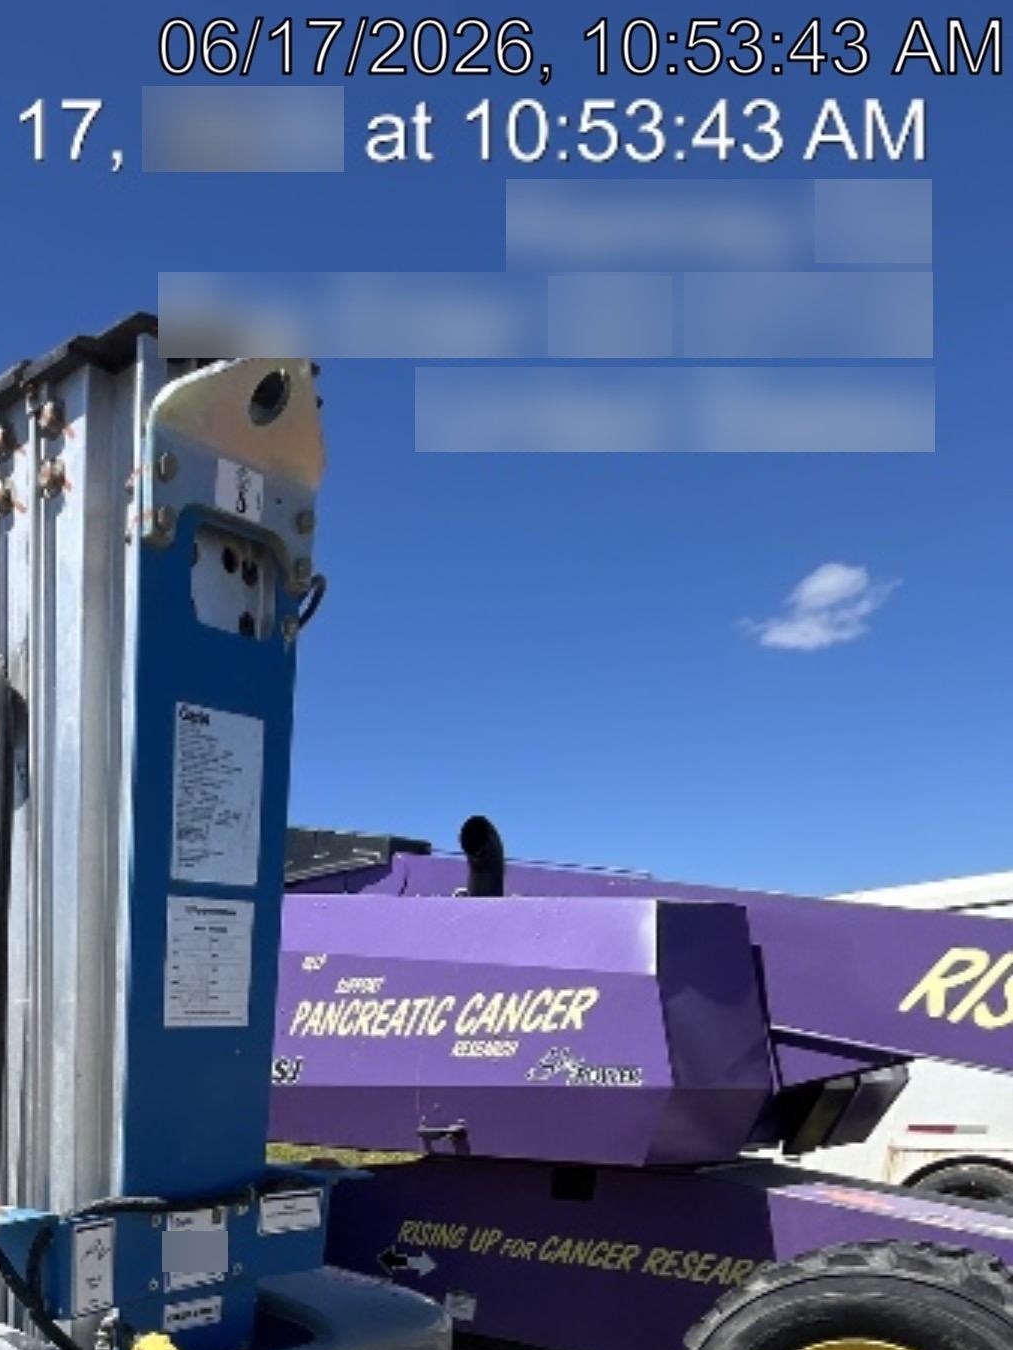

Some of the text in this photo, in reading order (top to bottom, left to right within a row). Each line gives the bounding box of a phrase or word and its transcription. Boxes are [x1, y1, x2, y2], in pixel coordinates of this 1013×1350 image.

[289, 986, 600, 1038] PANCREATIC CANCER
[398, 1219, 467, 1249] RISING
[469, 1226, 502, 1256] UP
[500, 1236, 538, 1261] FOR
[538, 1235, 642, 1273] CANCER
